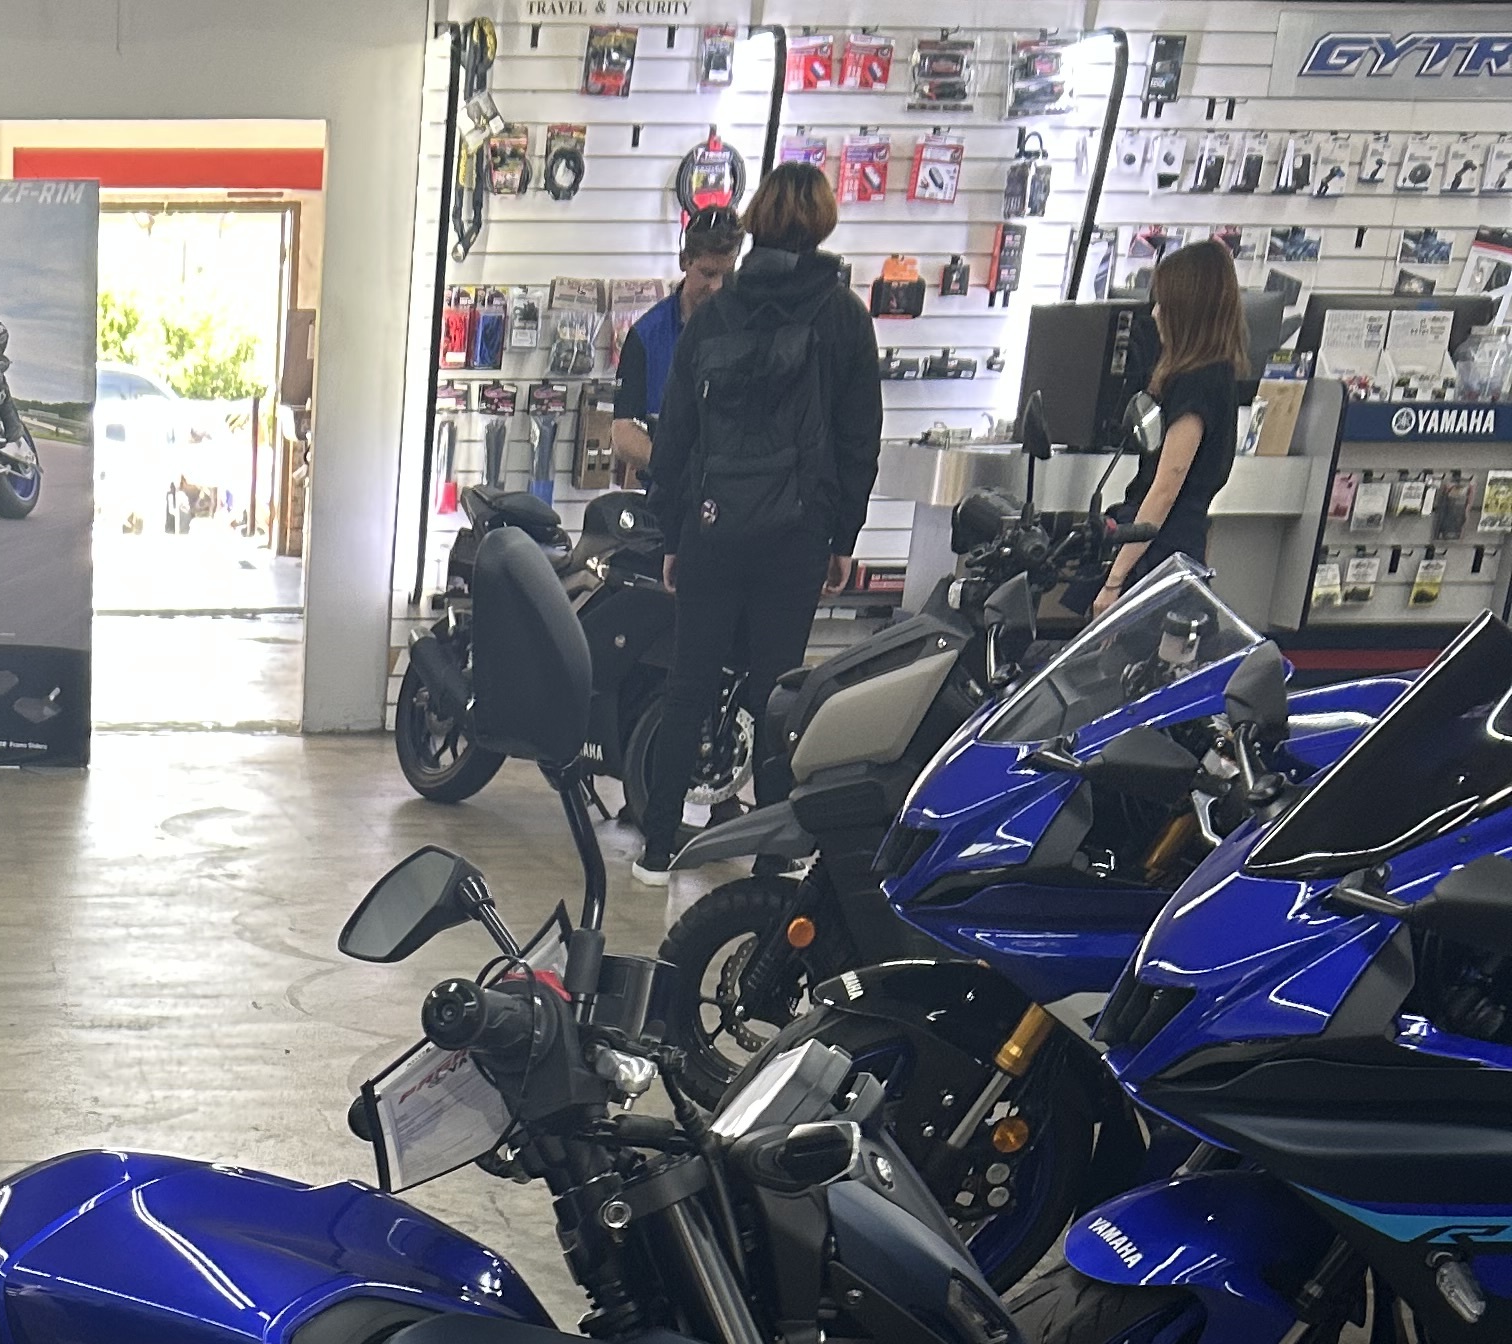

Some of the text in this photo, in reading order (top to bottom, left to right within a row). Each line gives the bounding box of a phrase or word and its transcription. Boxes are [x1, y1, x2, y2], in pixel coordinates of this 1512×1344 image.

[527, 0, 692, 15] TRAVEL & SECURITY
[1298, 31, 1512, 77] GYTR
[1417, 409, 1496, 434] YAMAHA
[1088, 1217, 1143, 1269] YAMAHA
